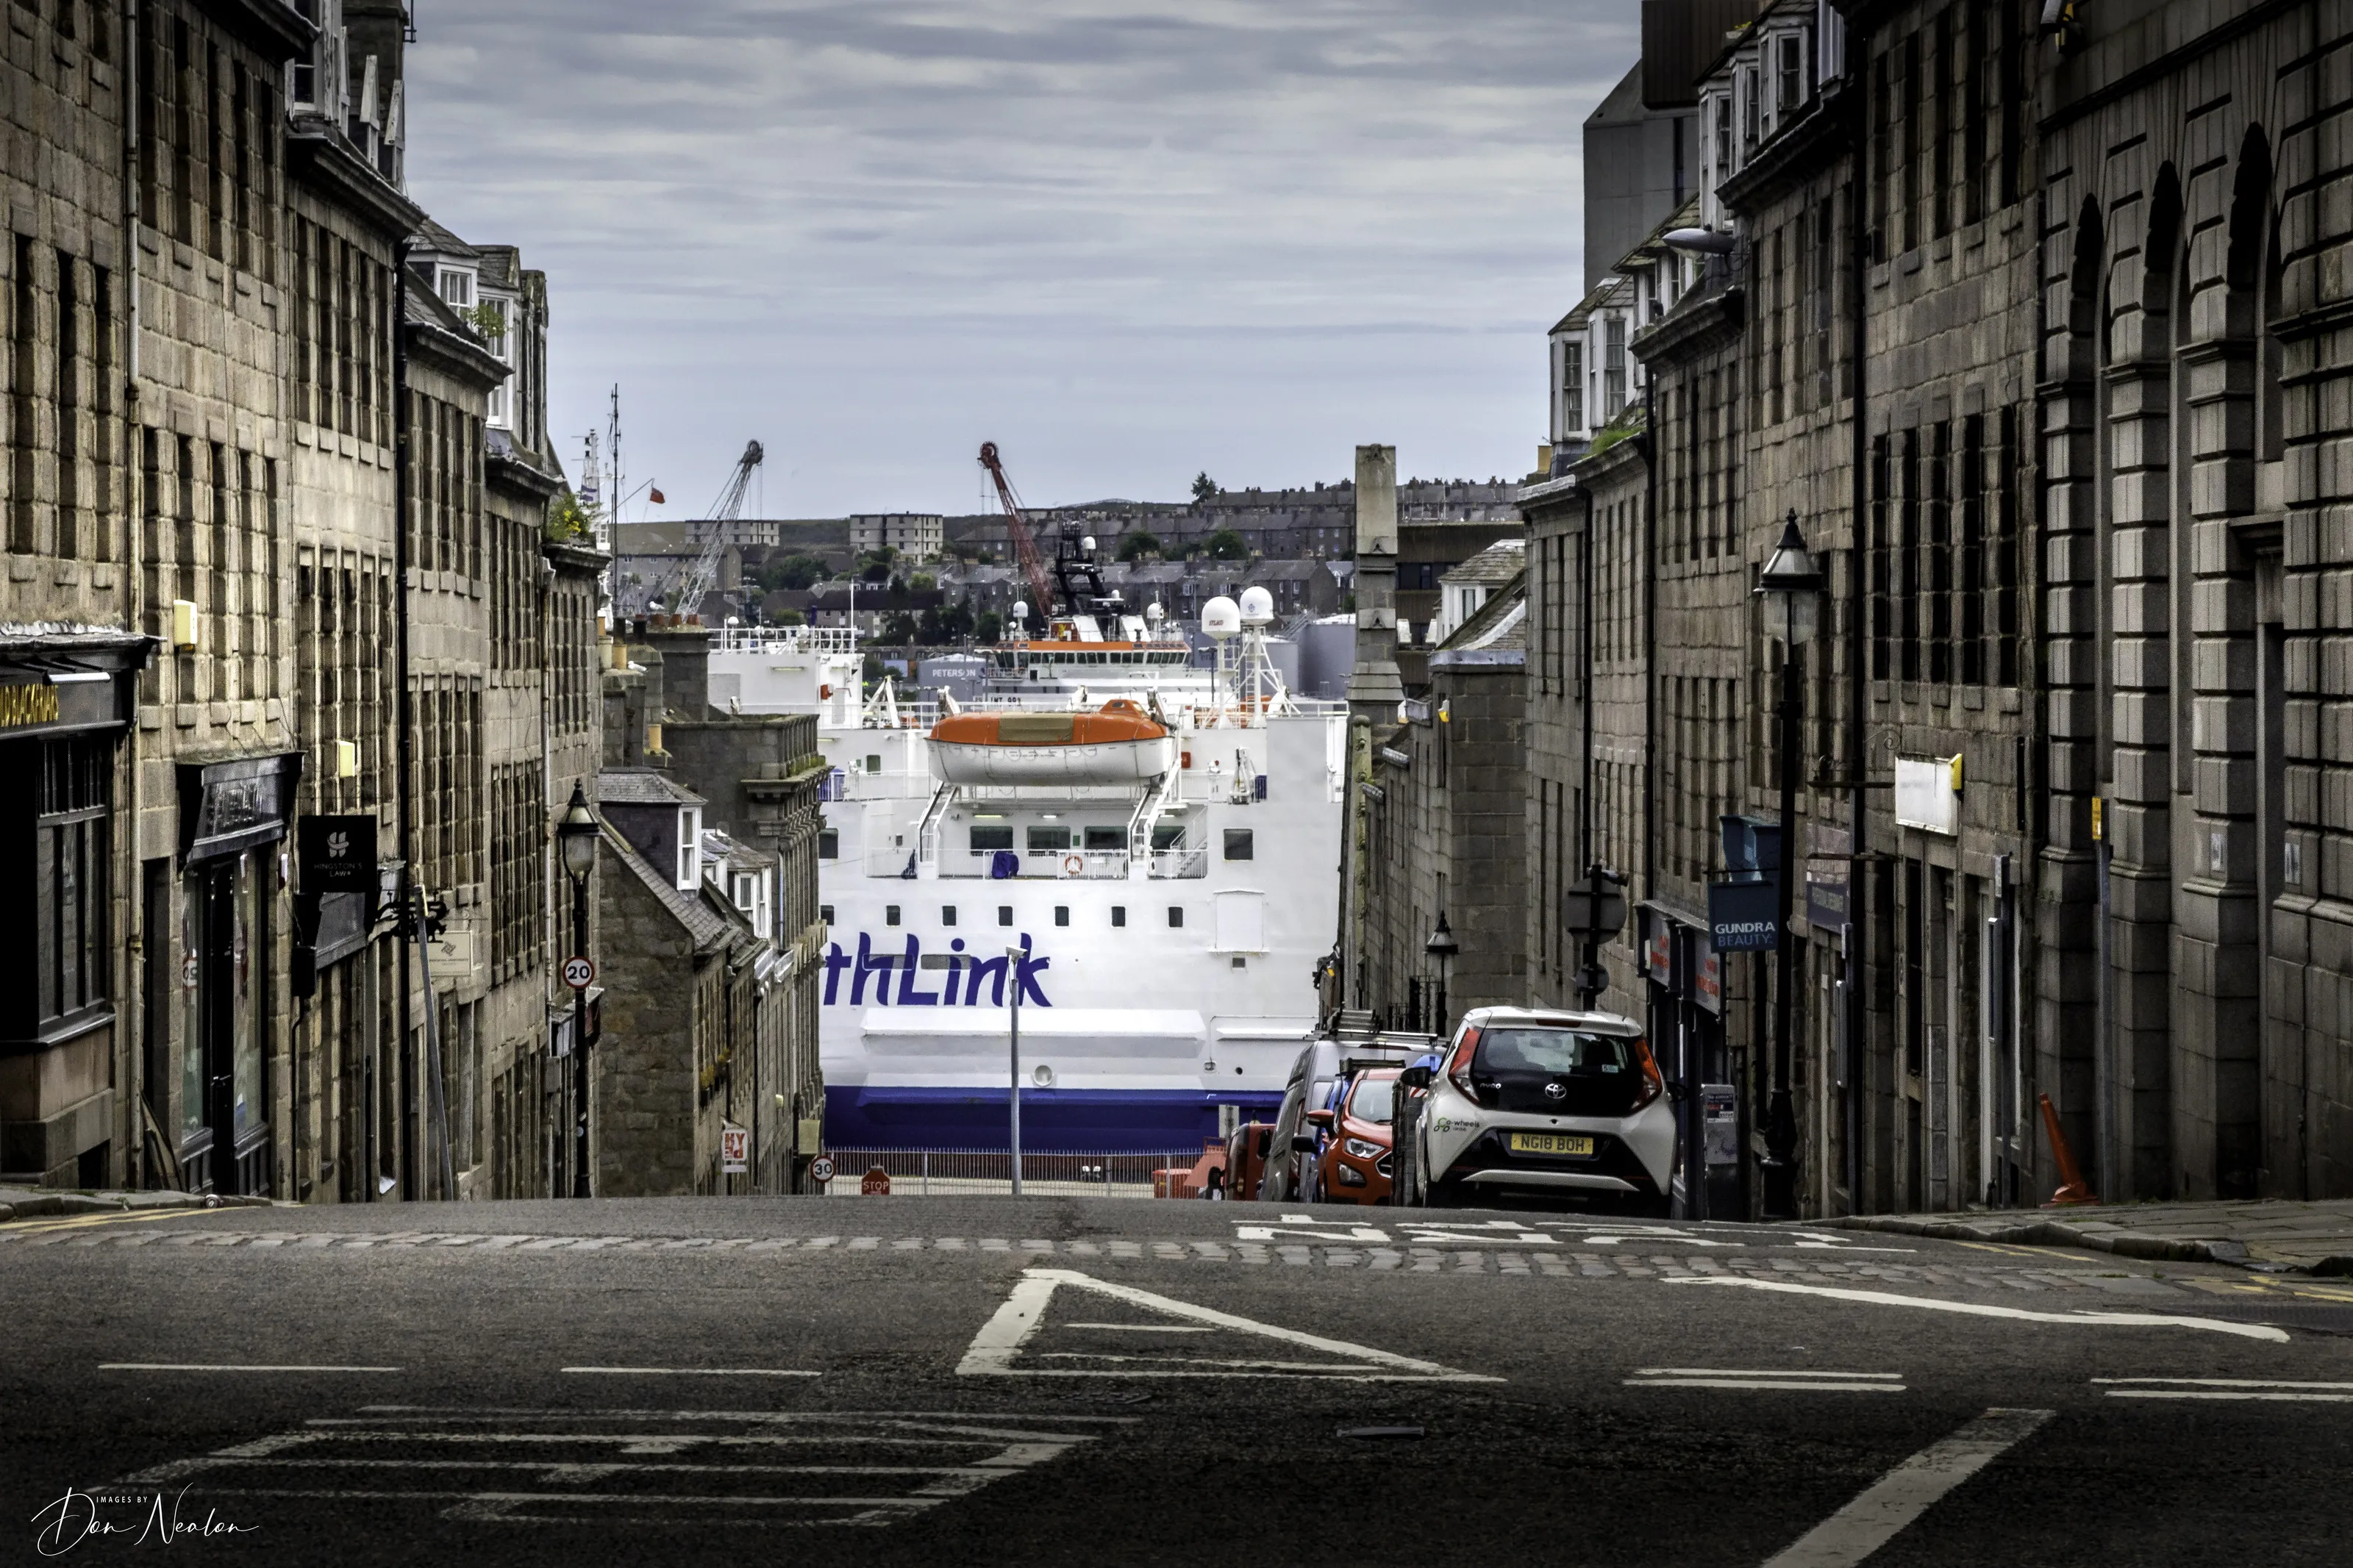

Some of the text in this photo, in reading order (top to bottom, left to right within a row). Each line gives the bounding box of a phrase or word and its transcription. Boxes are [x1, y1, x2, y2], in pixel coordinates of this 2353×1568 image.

[1715, 921, 1776, 934] GUNDRA
[567, 965, 590, 979] 20
[1521, 1134, 1585, 1152] NG18 BOH
[814, 1163, 833, 1175] 30
[863, 1181, 890, 1191] STOP
